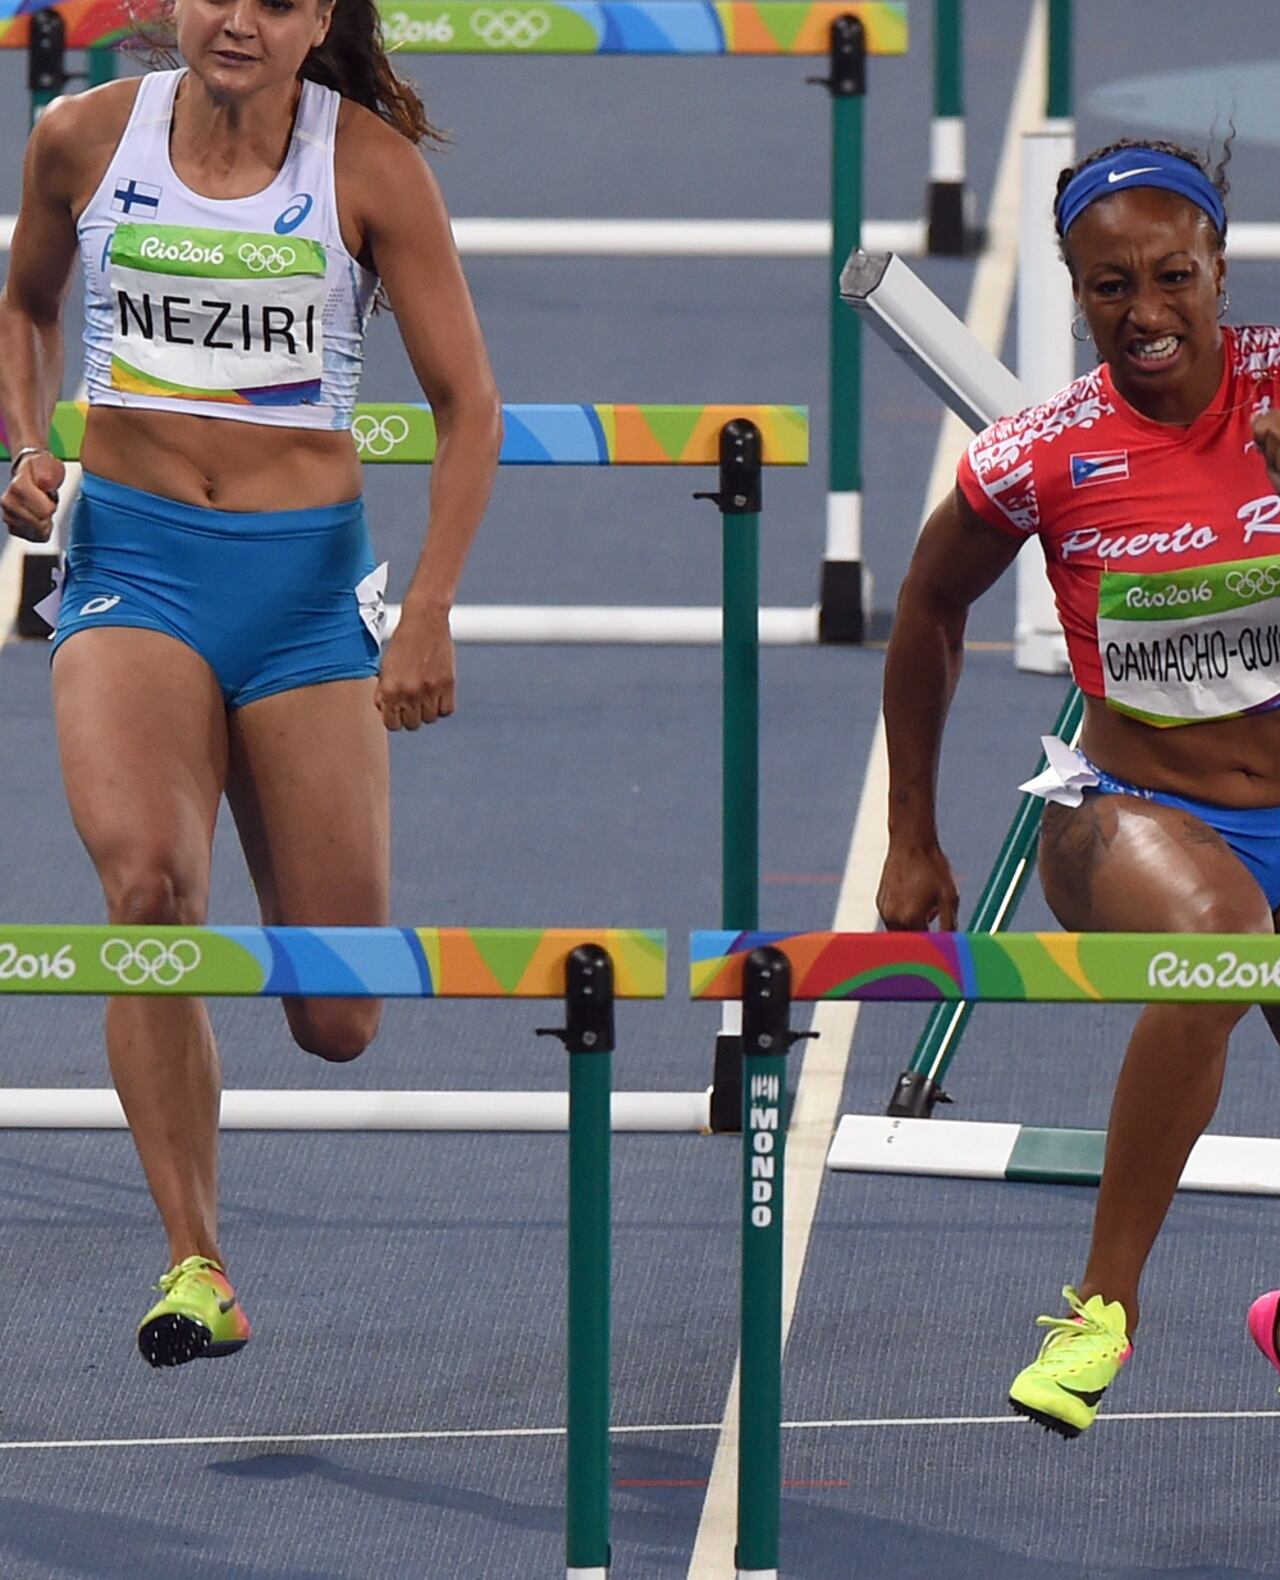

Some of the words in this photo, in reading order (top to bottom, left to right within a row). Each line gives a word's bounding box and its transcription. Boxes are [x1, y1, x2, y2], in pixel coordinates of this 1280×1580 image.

[140, 237, 224, 265] Rio2016
[117, 290, 315, 354] NEZIRI
[1061, 522, 1218, 560] Puerto
[1126, 580, 1213, 608] Rio2016
[750, 1107, 779, 1228] MONDO
